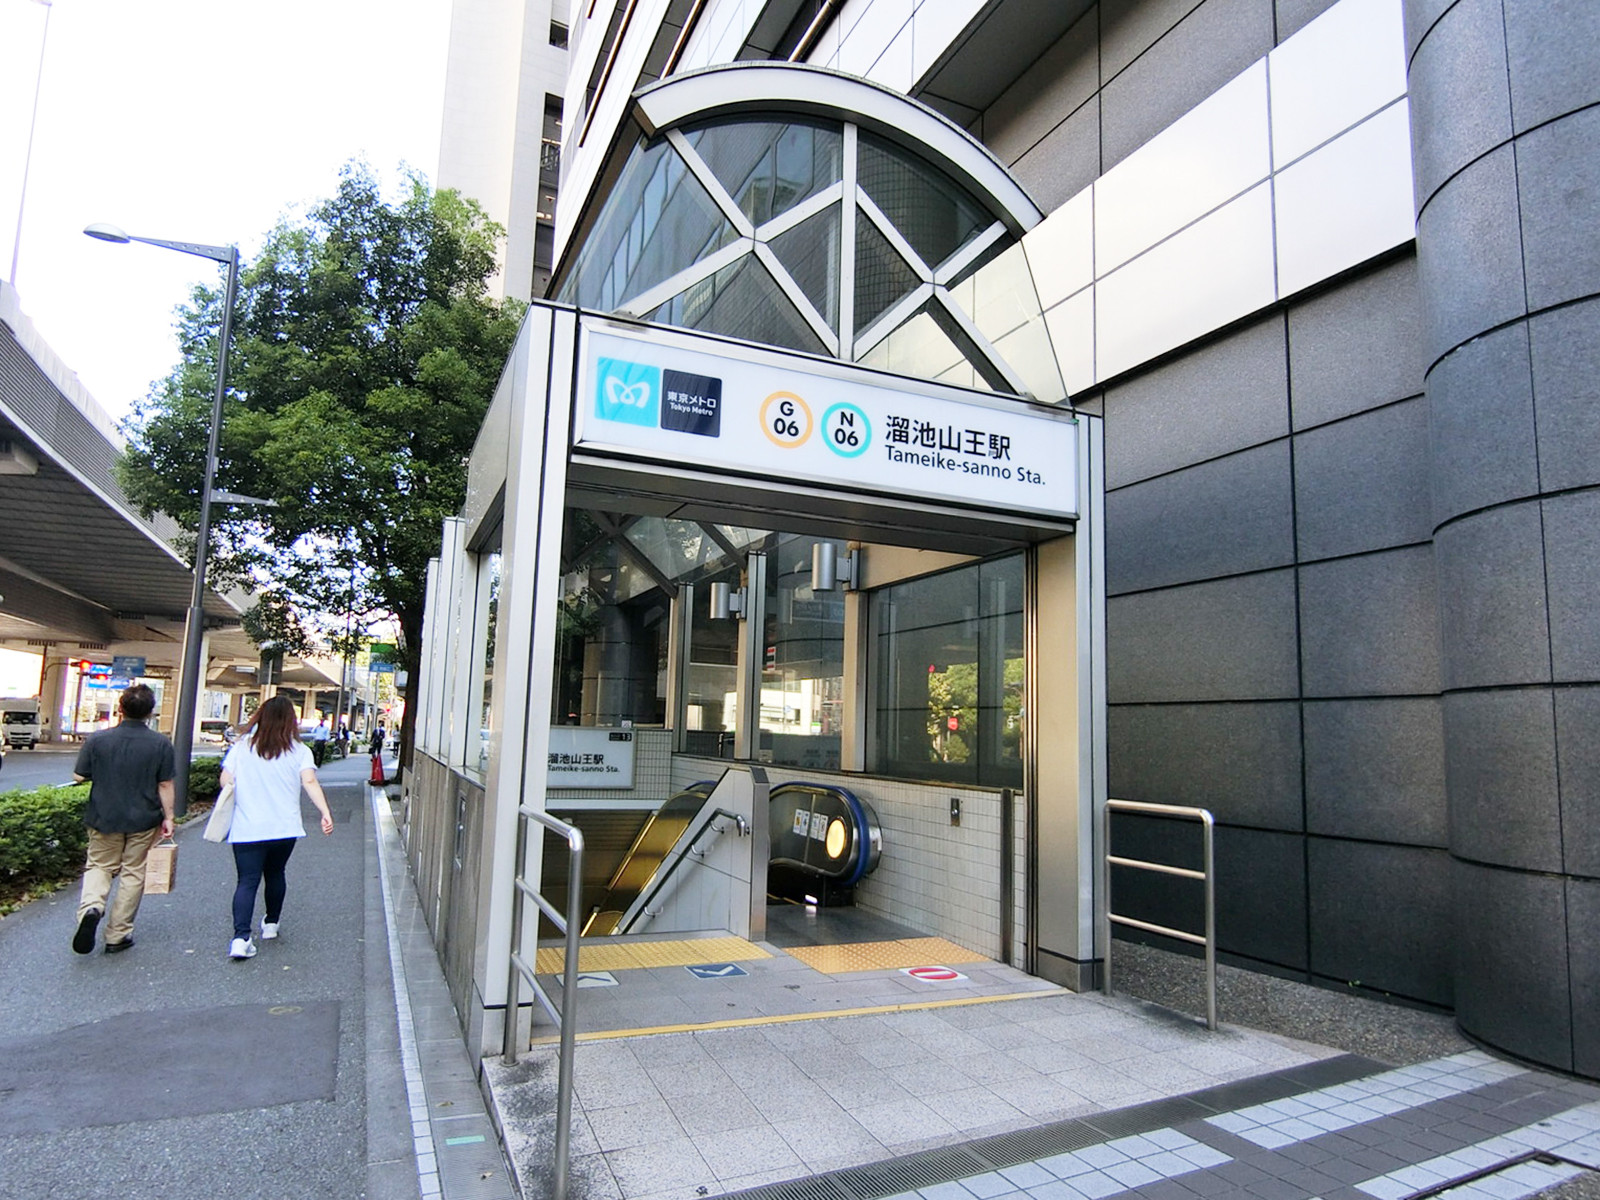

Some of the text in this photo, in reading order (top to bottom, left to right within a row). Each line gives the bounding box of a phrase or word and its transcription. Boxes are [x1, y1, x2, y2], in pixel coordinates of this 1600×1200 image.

[667, 390, 717, 409] 東京メトロ
[669, 402, 713, 416] Tokyo Metro
[780, 401, 794, 416] G
[773, 417, 799, 437] 06
[840, 411, 854, 427] N
[834, 428, 859, 447] 06
[885, 414, 1011, 461] 溜池山王駅
[884, 444, 1046, 486] Tameike-sanno Sta.
[548, 753, 604, 764] 溜池山王駅
